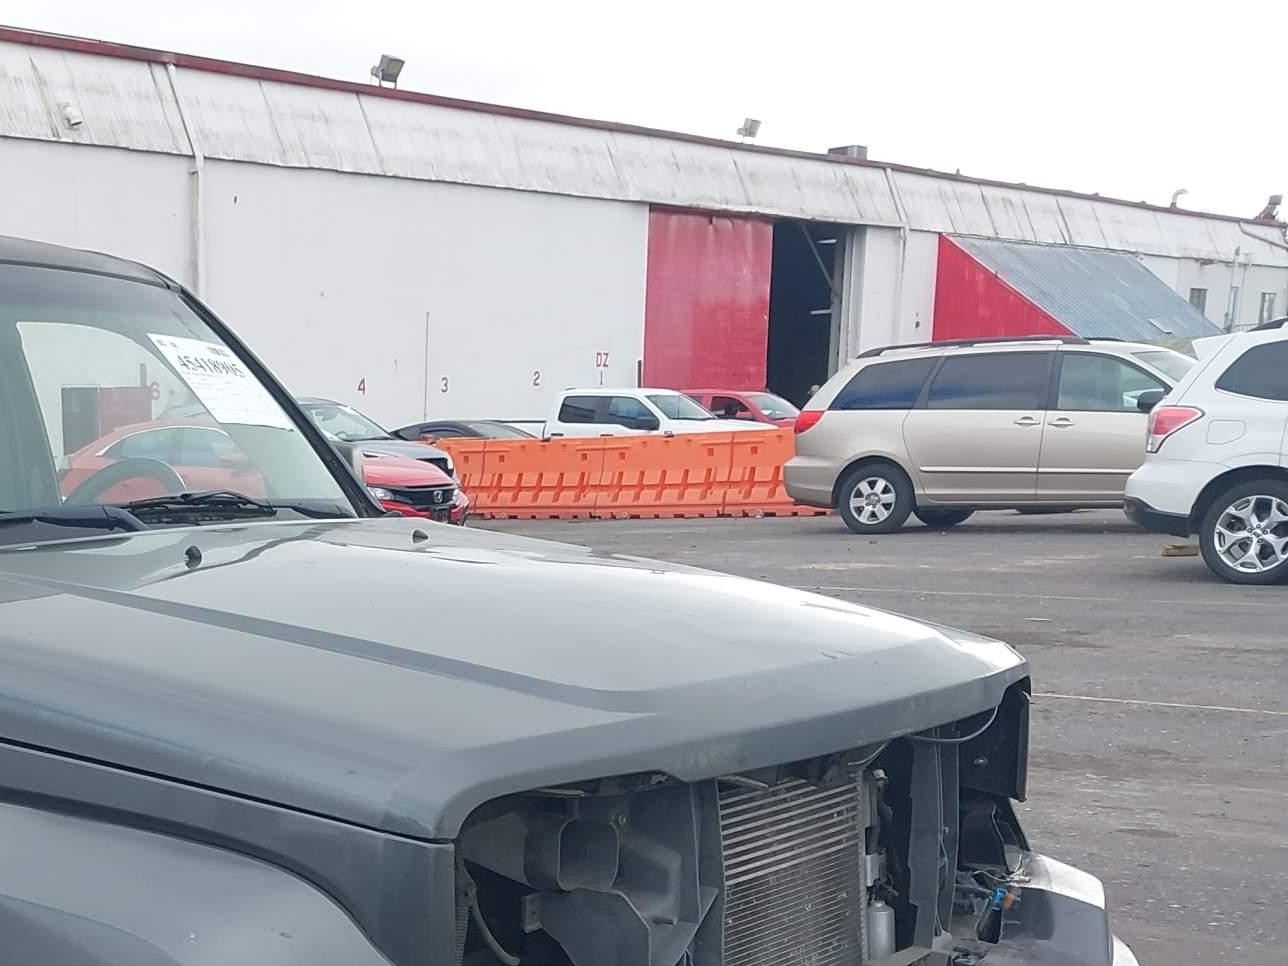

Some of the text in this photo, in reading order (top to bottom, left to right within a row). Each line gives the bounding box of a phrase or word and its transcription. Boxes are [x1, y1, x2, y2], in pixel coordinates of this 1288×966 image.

[357, 377, 367, 396] 4
[440, 376, 449, 394] 3
[532, 370, 541, 387] 2
